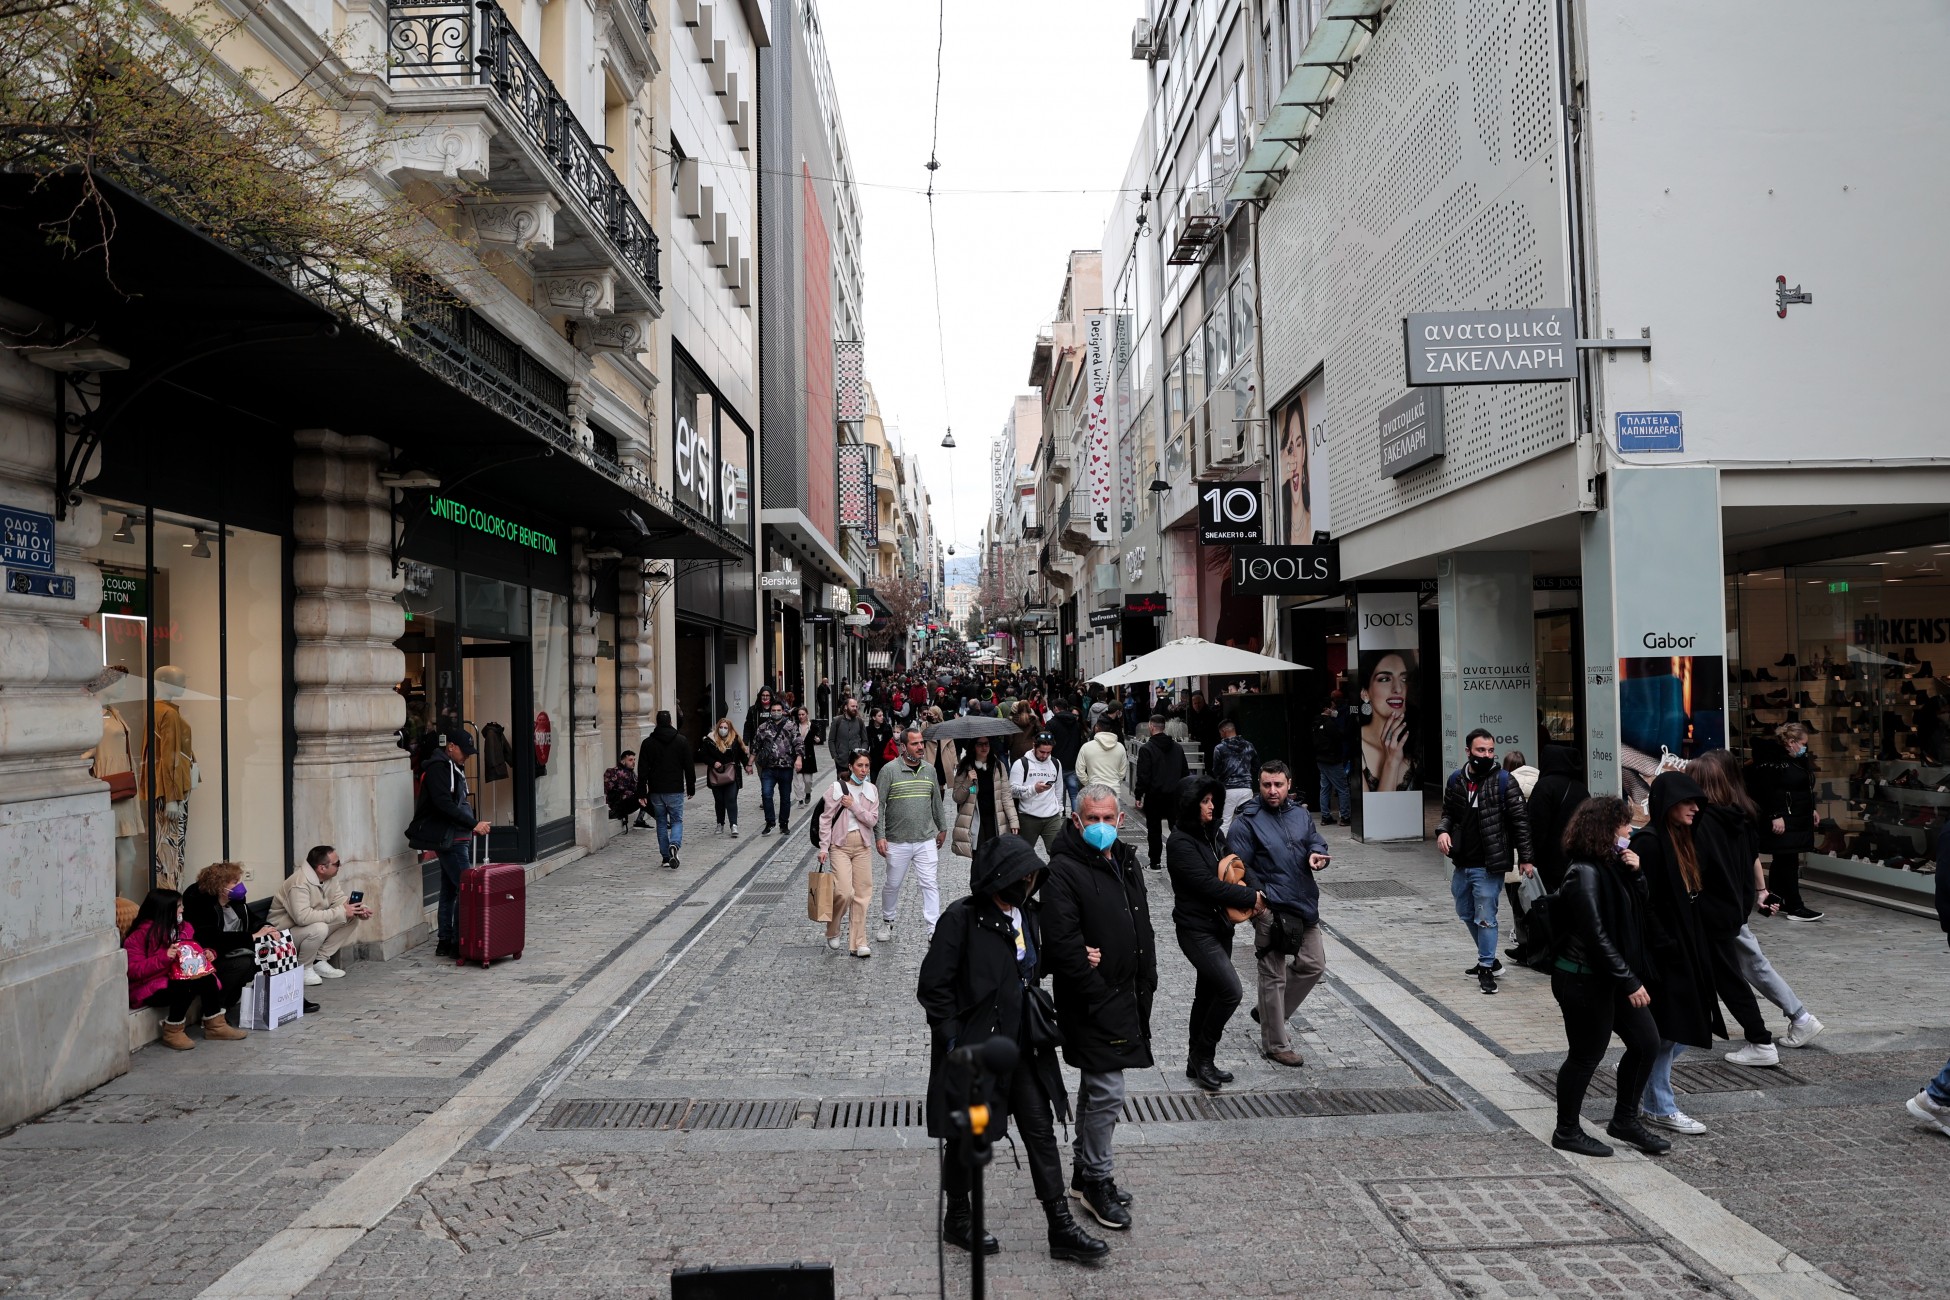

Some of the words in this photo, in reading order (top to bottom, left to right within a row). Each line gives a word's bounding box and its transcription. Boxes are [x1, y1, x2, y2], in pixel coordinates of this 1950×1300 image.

[1424, 315, 1563, 343] ανατομικά
[1088, 319, 1103, 366] Designed
[1425, 348, 1564, 373] ΣΑΚΕΛΛΑΡΗ
[1093, 368, 1104, 393] with
[1382, 395, 1426, 437] ανατομικά
[1626, 416, 1669, 426] ΠΛΑΤΕΙΑ
[1621, 425, 1680, 436] ΚΑΠΝΙΚΑΡΕΑΣ
[1383, 427, 1427, 466] ΣΑΚΕΛΛΑΡΗ
[993, 441, 1002, 482] SPENCER
[1203, 488, 1258, 523] 10
[4, 517, 39, 534] ΟΔΟΣ
[430, 494, 468, 525] UNITED
[469, 508, 506, 538] COLORS
[506, 522, 518, 541] OF
[1205, 531, 1258, 539] SNEAKER10.GR
[1237, 557, 1329, 586] JOOLS
[106, 577, 136, 590] COLORS
[761, 576, 798, 586] Bershka
[1091, 613, 1118, 622] sofronas
[1363, 612, 1413, 630] JOOLS
[1642, 632, 1697, 649] Gabor
[1463, 663, 1531, 675] ανατομικά
[1463, 679, 1531, 691] ΣΑΚΕΛΛΑΡΗ
[1479, 712, 1503, 724] these
[1592, 727, 1604, 739] these
[1592, 747, 1613, 761] shoes
[1592, 769, 1603, 779] are
